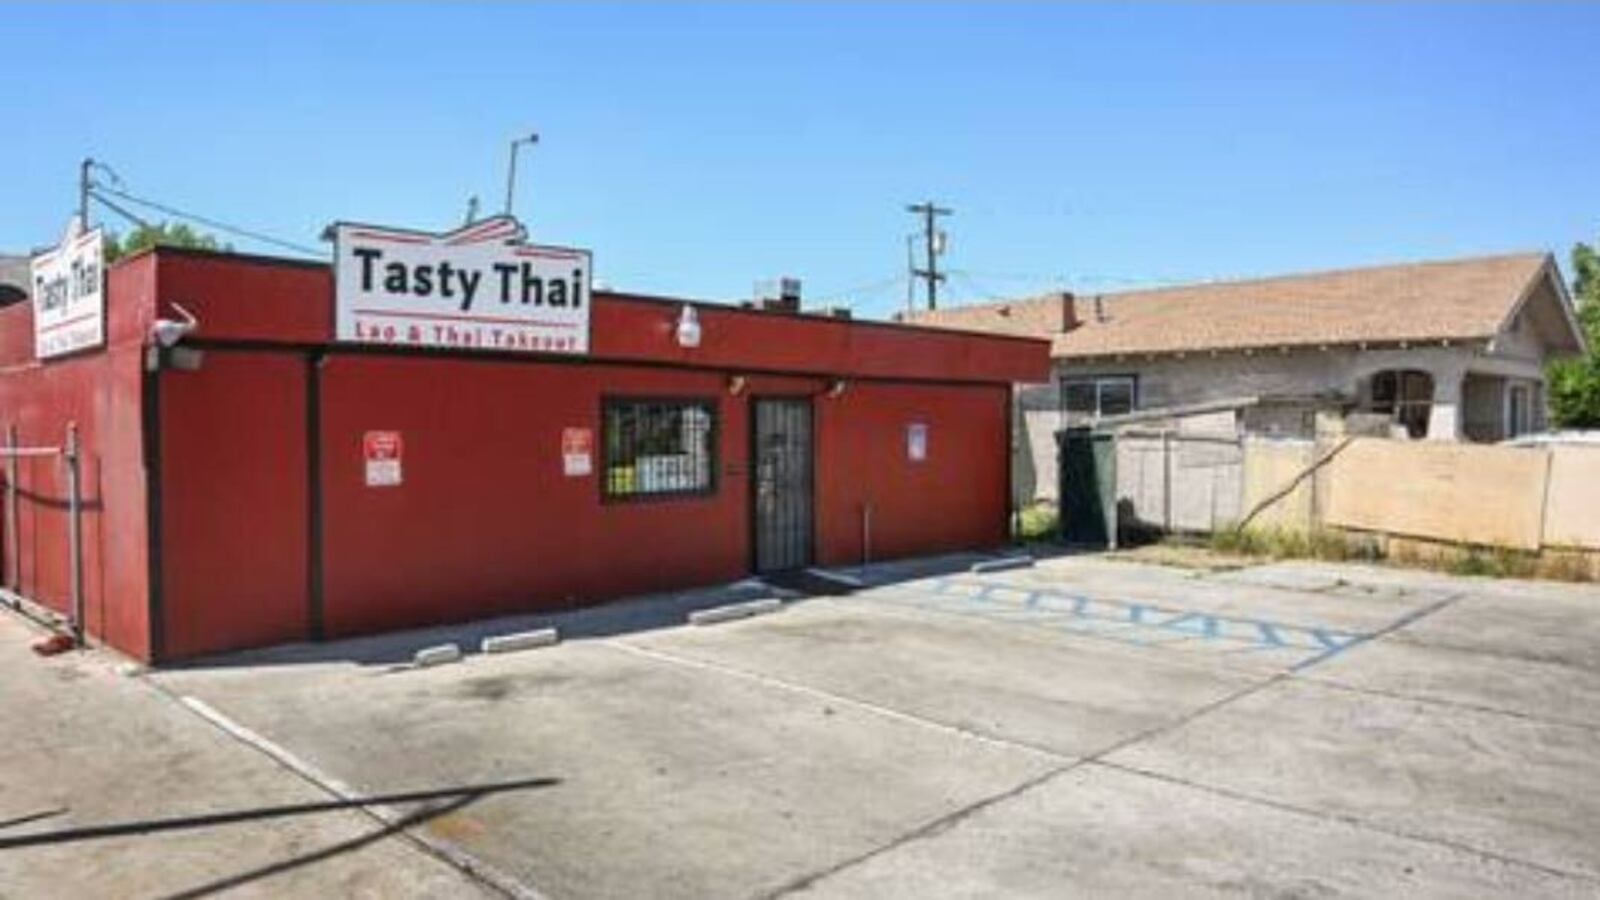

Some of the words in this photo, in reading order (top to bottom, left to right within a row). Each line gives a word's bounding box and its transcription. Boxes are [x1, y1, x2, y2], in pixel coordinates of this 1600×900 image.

[353, 247, 482, 311] Tasty
[493, 261, 583, 308] Thai
[433, 326, 482, 346] Thai
